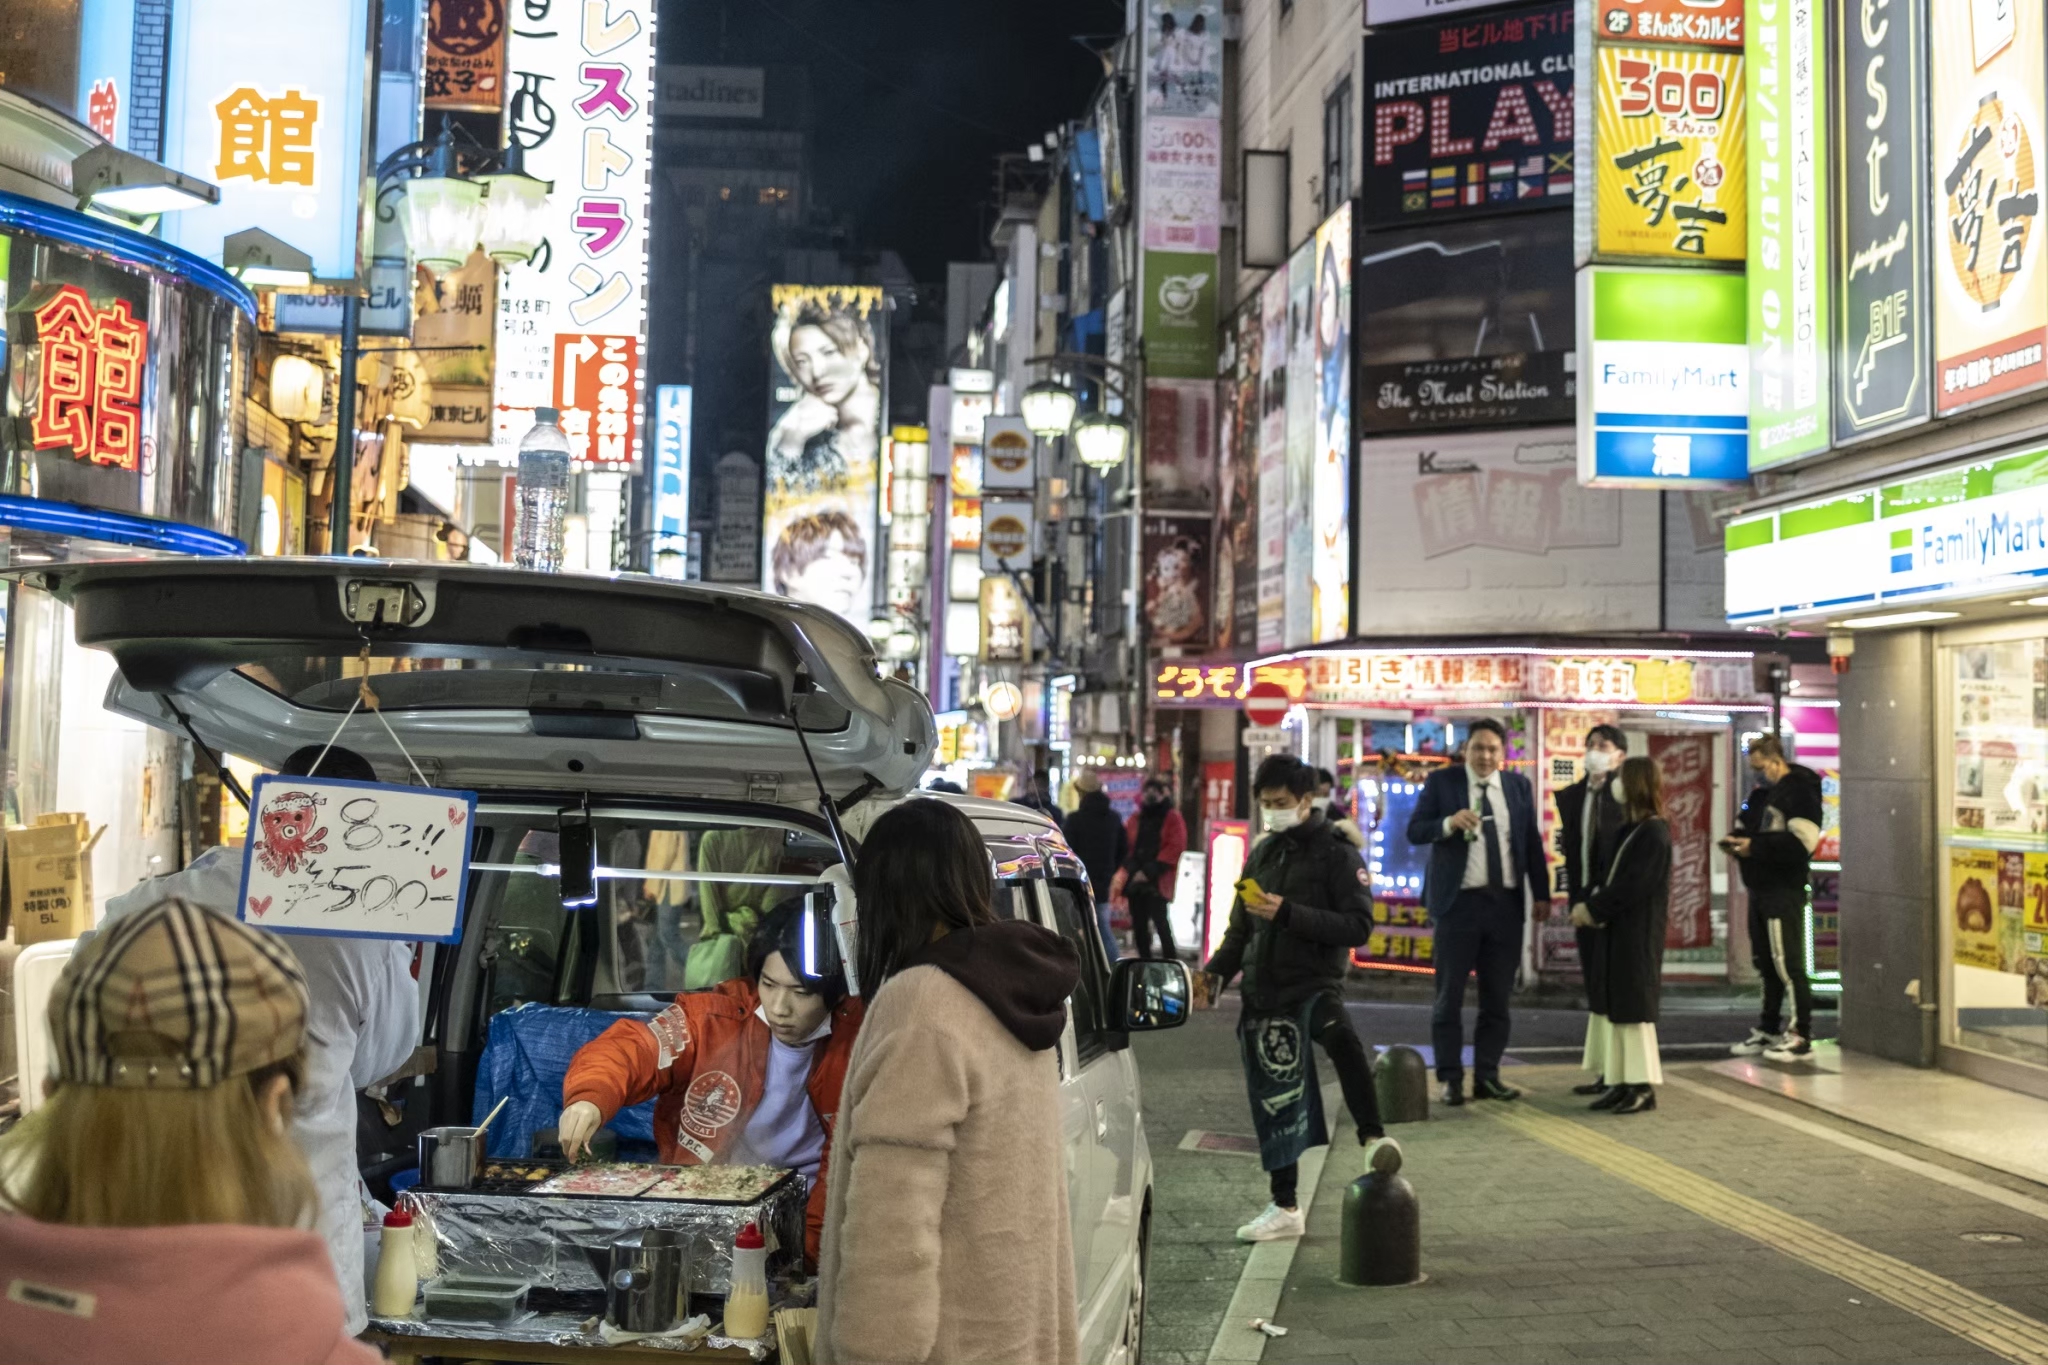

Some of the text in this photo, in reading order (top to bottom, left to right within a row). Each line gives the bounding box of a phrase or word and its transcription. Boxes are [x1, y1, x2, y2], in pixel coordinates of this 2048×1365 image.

[1607, 10, 1630, 33] 2F
[1374, 60, 1535, 99] INTERNATIONAL
[1618, 58, 1721, 117] 300
[213, 87, 319, 187] 館
[1374, 80, 1574, 167] PLAY
[570, 0, 641, 326] レストラン
[1869, 288, 1908, 344] B1F
[33, 284, 148, 470] 館
[1377, 374, 1549, 409] The Meat Station
[1603, 363, 1738, 392] FamilyMart
[429, 405, 487, 425] 東京ビル
[1922, 507, 2046, 567] FamilyMart
[40, 912, 59, 925] 5L
[682, 1112, 712, 1136] TOMCAT
